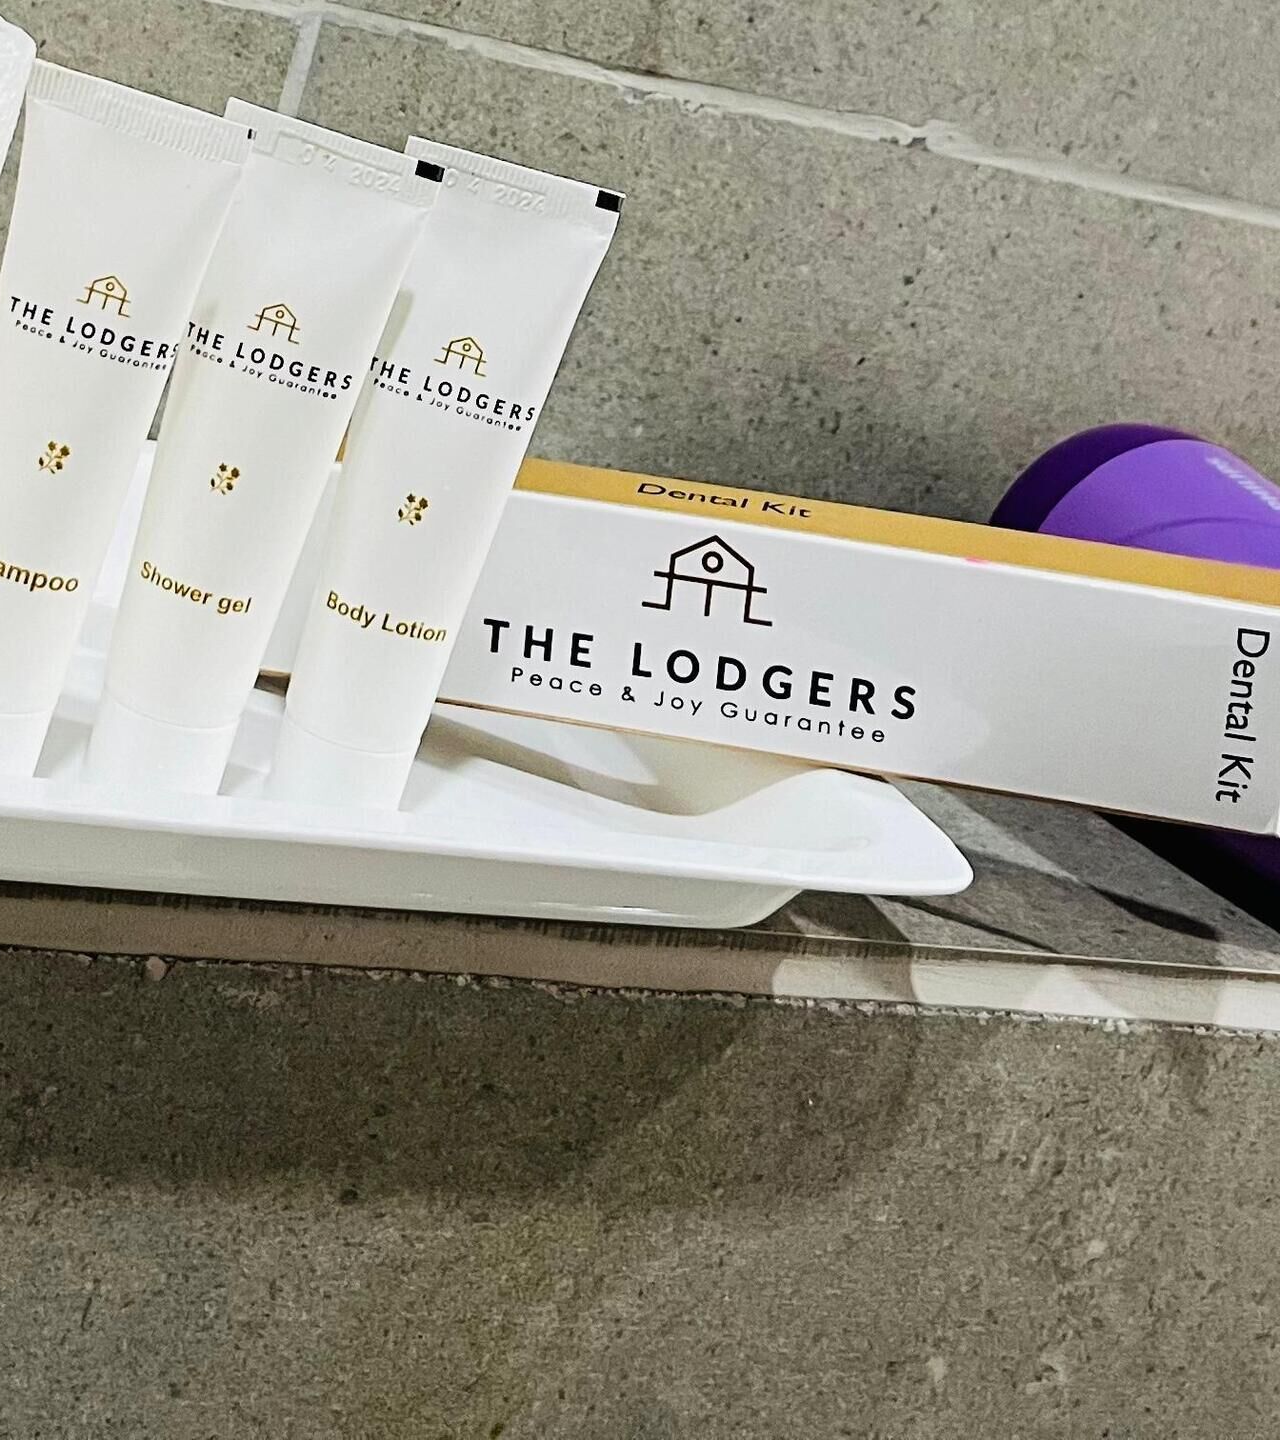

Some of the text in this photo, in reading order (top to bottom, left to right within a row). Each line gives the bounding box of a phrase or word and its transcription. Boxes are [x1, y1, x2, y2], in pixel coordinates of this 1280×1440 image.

[11, 296, 54, 326] THE
[15, 319, 53, 339] Peace
[59, 335, 66, 344] &
[73, 340, 93, 355] Joy
[187, 321, 353, 390] THE LODGERS
[190, 344, 337, 399] Peace & Joy Guarantee
[370, 356, 536, 421] THE LODGERS
[373, 378, 521, 432] Peace & Joy Guarantee
[637, 482, 813, 519] Dental Kit
[140, 561, 253, 615] Shower gel
[326, 590, 447, 642] Body Lotion
[483, 618, 917, 721] THE LODGERS
[511, 667, 886, 744] Peace & Joy Guarantee
[1215, 627, 1271, 803] Dental Kit
